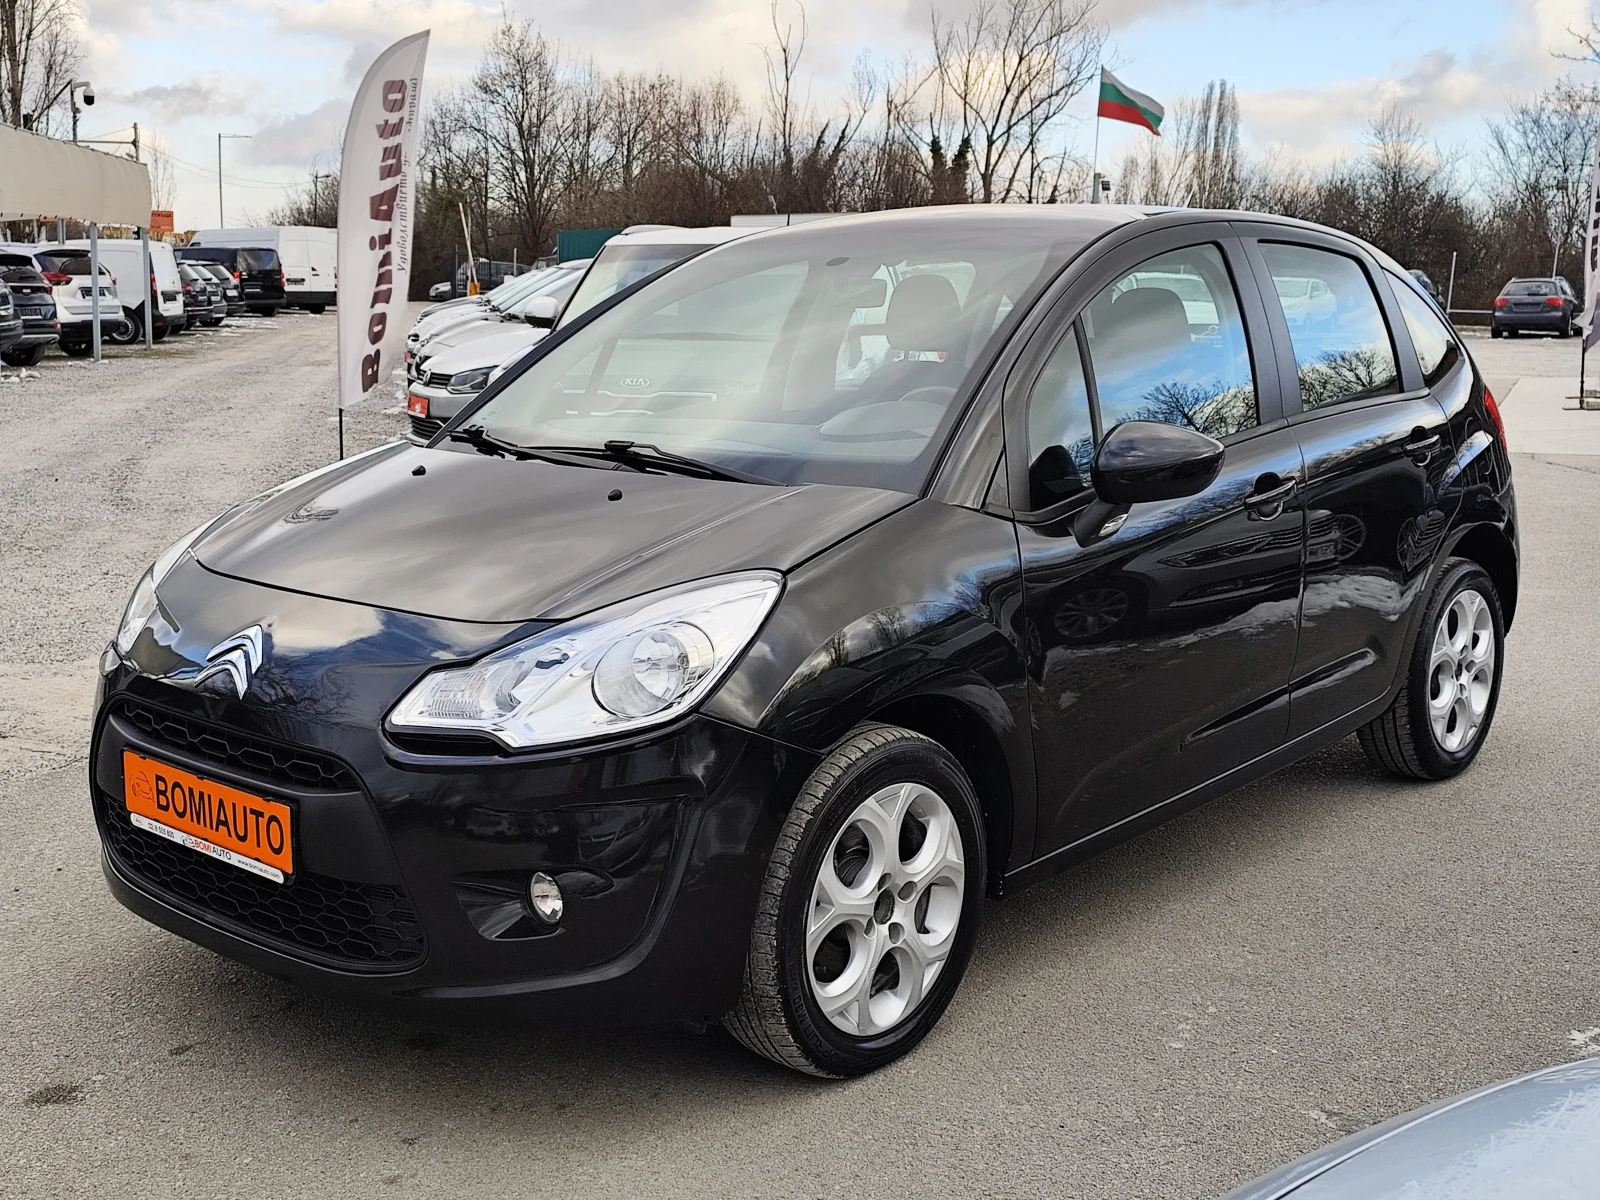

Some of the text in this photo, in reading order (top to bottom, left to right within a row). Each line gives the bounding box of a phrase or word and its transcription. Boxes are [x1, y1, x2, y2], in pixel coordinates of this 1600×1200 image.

[362, 79, 407, 394] BomiAuto
[624, 377, 645, 386] KIA
[155, 773, 285, 855] BOMIAUTO
[194, 839, 211, 853] BOMI
[212, 846, 232, 860] AUTO
